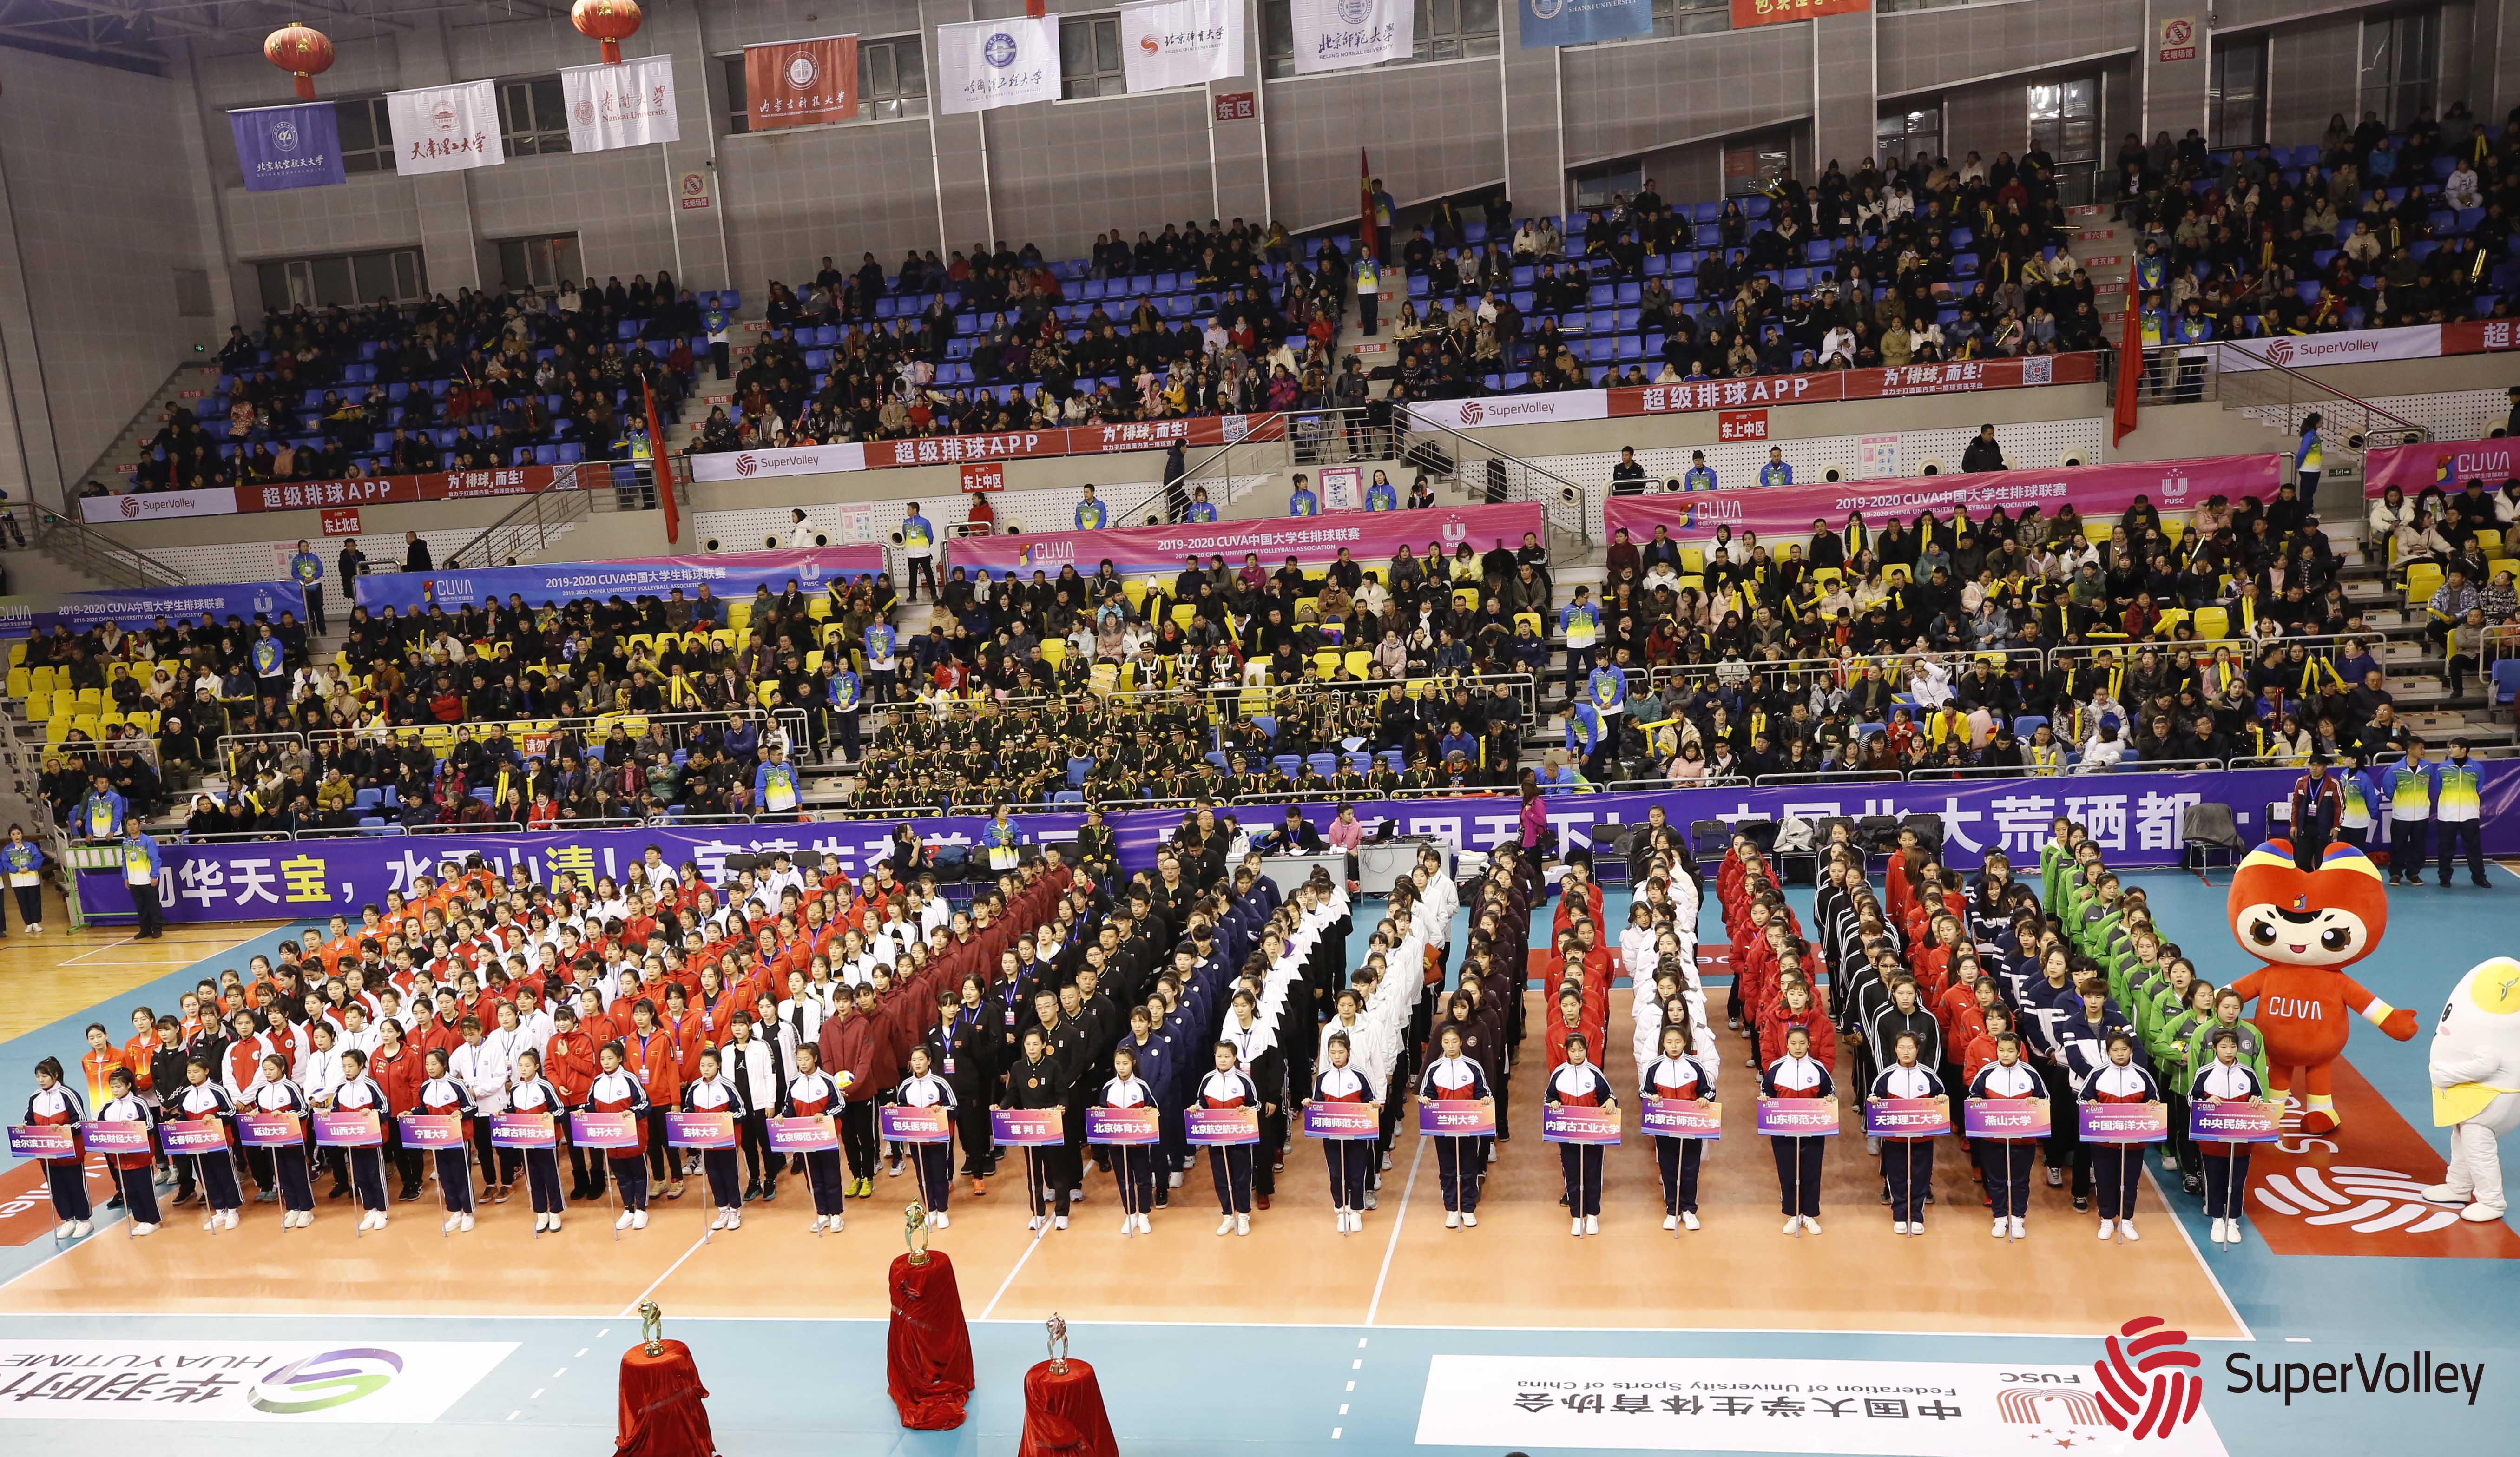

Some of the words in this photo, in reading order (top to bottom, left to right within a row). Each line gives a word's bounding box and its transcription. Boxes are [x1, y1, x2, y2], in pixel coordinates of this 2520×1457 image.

[1364, 43, 1393, 54] UNIVERSITY
[603, 112, 629, 123] Nankai
[631, 108, 669, 120] University
[1217, 100, 1252, 119] 东区
[2092, 257, 2116, 266] 第五排
[2099, 283, 2124, 293] 第四排
[2109, 313, 2125, 321] 第三
[2300, 339, 2378, 356] SuperVolley
[1643, 377, 1809, 412] 超级排球APP
[1487, 401, 1555, 418] SuperVolley
[1722, 421, 1766, 439] 东上中区
[895, 433, 1039, 464] 超级排球APP
[760, 454, 819, 470] SuperVolley
[2458, 451, 2510, 473] CUVA
[963, 473, 1002, 490] 东上中区
[263, 480, 391, 508] 超级排球APP
[143, 497, 195, 512] SuperVolley
[1836, 495, 1900, 510] 2019-2020
[1697, 500, 1742, 519] CUVA
[324, 517, 360, 534] 东上北区
[1034, 541, 1075, 559] CUVA
[1157, 537, 1214, 552] 2019-2020
[1260, 546, 1295, 554] VOLLEYBALL
[1296, 544, 1336, 552] ASSOCIATION
[437, 579, 474, 596] CUVA
[546, 575, 596, 588] 2019-2020
[58, 604, 105, 616] 2019-2020
[2269, 996, 2322, 1020] CUVA
[1311, 1117, 1372, 1128] 河南师范大学
[1436, 1115, 1479, 1125] 兰州大学
[1644, 1113, 1719, 1128] 内蒙古师范大学
[1765, 1114, 1832, 1125] 山东师范大学
[1875, 1114, 1942, 1126] 天津理工大学
[1985, 1115, 2031, 1127] 燕山大学
[2089, 1120, 2160, 1131] 中国海洋大学
[2199, 1118, 2272, 1131] 中央民族大学
[253, 1126, 287, 1137] 延边大学
[330, 1126, 366, 1136] 山西大学
[493, 1127, 554, 1138] 内蒙古科技大学
[586, 1127, 623, 1137] 南开大学
[682, 1127, 719, 1138] 吉林大学
[892, 1121, 938, 1132] 包头医学院
[1093, 1123, 1152, 1134] 北京体育大学
[1191, 1124, 1255, 1134] 北京航空航天大学
[1546, 1120, 1619, 1134] 内蒙古工业大学
[89, 1133, 143, 1144] 中央财经大学
[168, 1132, 220, 1146] 长春师范大学
[415, 1128, 448, 1139] 宁夏大学
[775, 1131, 830, 1143] 北京师范大学
[12, 1138, 73, 1149] 哈尔滨工程大学
[1999, 1372, 2081, 1385] FUSC
[0, 1371, 242, 1403] 华羽时
[1517, 1381, 1577, 1390] China
[1584, 1381, 1605, 1390] of
[1612, 1381, 1682, 1391] Sports
[1690, 1381, 1799, 1393] University
[1807, 1384, 1828, 1392] of
[1836, 1384, 1957, 1396] Federation
[1513, 1392, 1962, 1421] 中国大学生体育协会
